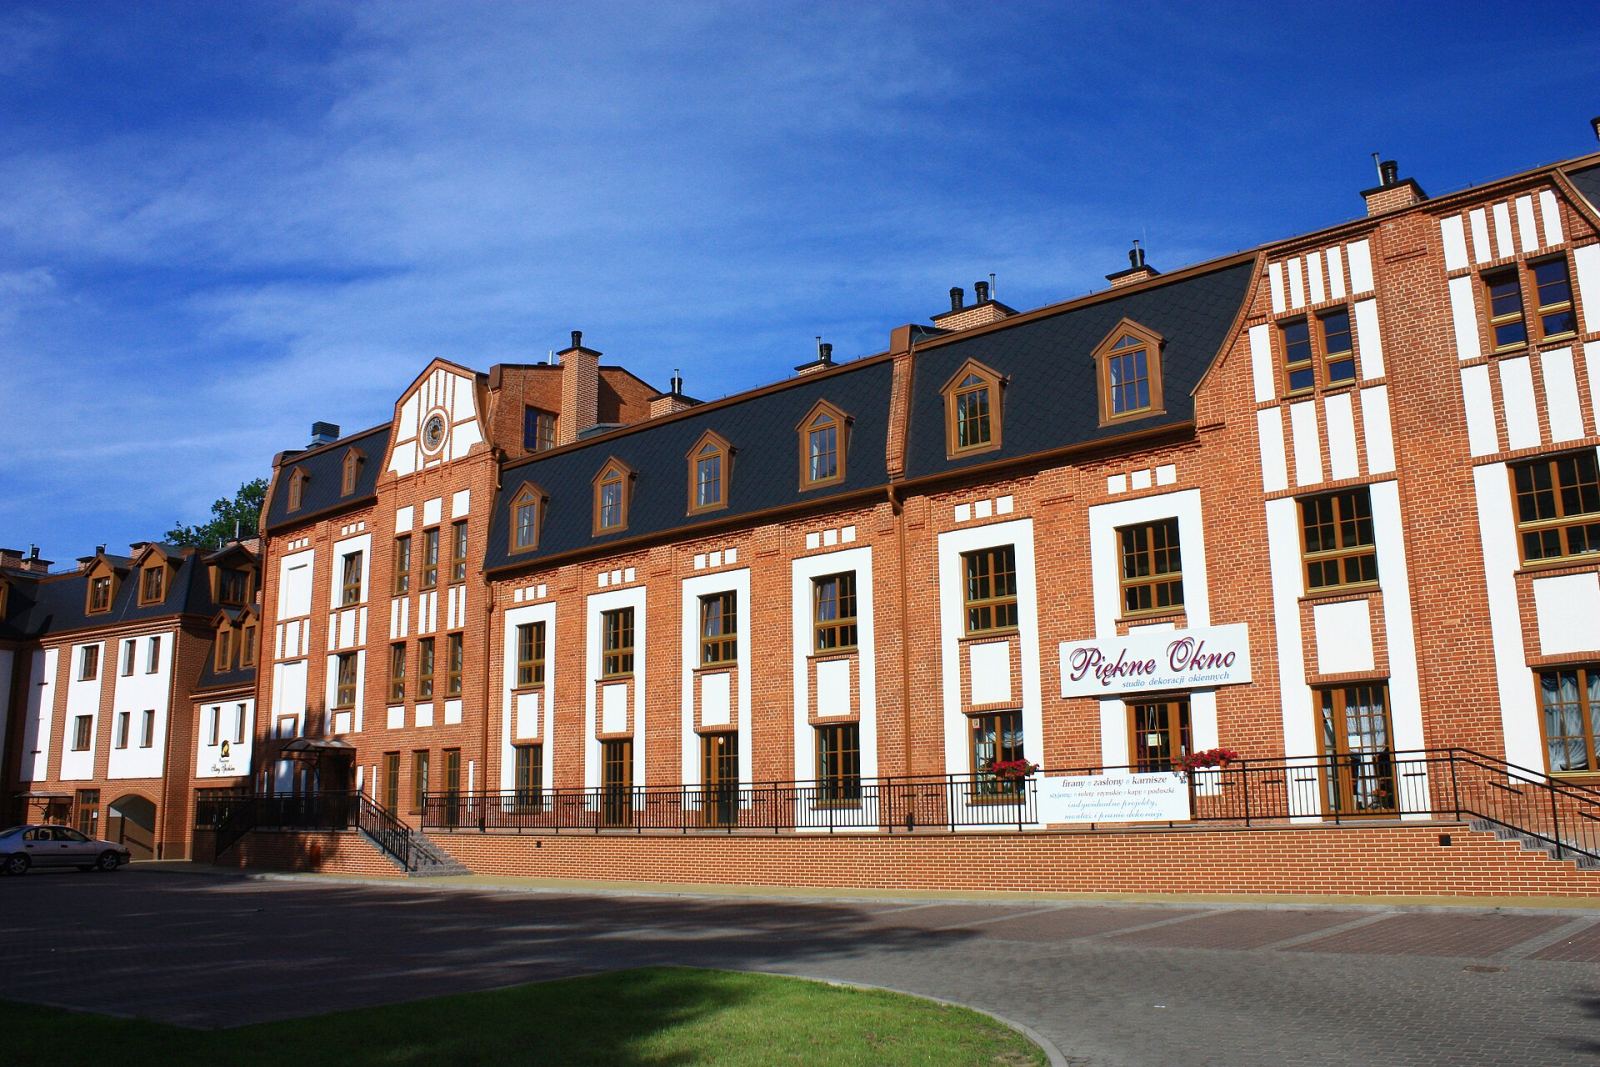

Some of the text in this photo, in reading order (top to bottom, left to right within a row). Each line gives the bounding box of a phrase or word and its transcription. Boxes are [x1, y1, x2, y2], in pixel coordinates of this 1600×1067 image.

[1069, 636, 1236, 687] Piękne Okno
[1122, 671, 1230, 688] studio dekoracji okiennych
[1062, 778, 1085, 788] firany
[1131, 775, 1167, 785] karnisze
